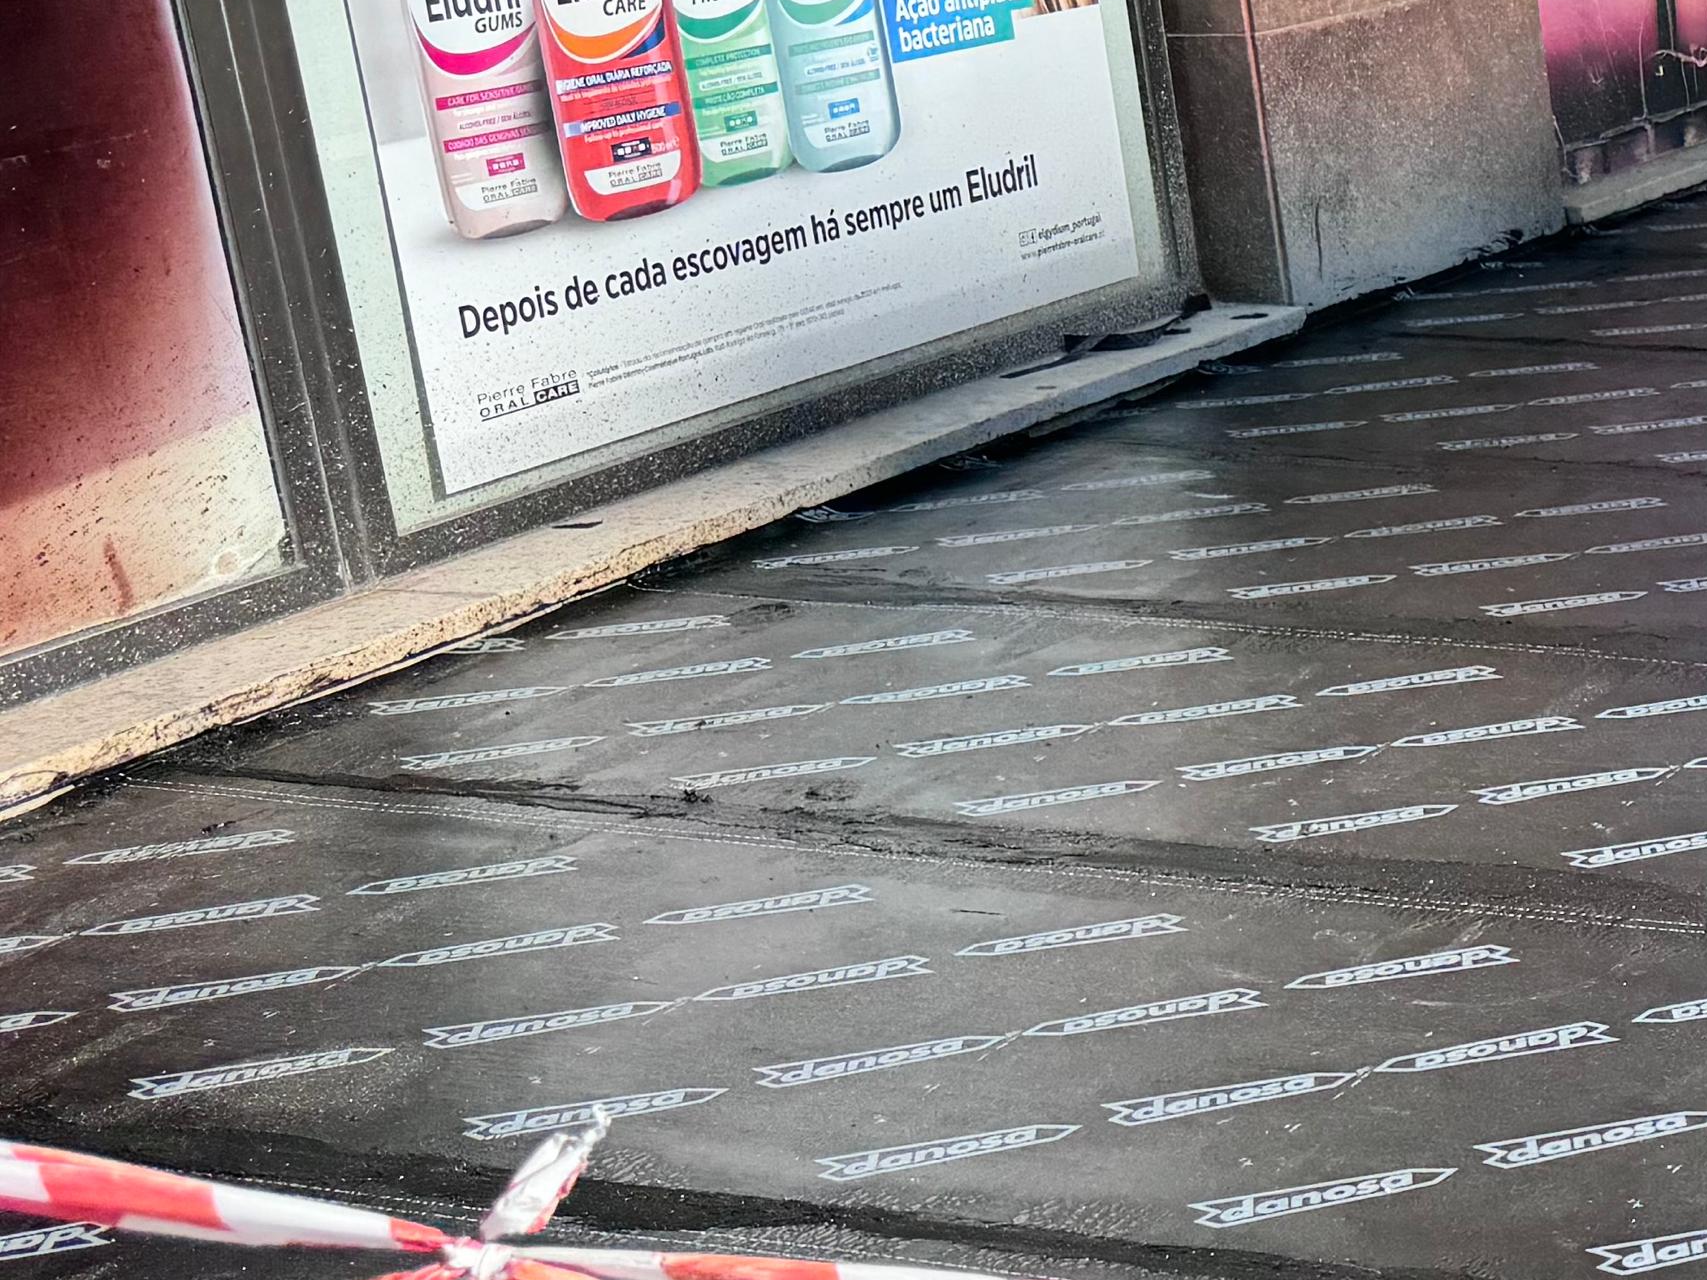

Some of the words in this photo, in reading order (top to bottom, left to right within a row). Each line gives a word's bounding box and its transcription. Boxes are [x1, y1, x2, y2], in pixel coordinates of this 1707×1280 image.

[475, 11, 523, 33] GUMS
[898, 14, 995, 53] bacteriana
[458, 285, 559, 338] Depois
[565, 275, 599, 311] de
[605, 258, 667, 299] cada
[672, 224, 807, 281] escovagem
[811, 209, 840, 244] há
[845, 193, 925, 236] sempre
[929, 185, 962, 212] um
[966, 154, 1038, 202] Eludril
[477, 384, 525, 404] Pierre
[531, 369, 576, 389] Fabre
[480, 397, 529, 418] ORAL
[535, 381, 579, 403] CARE
[120, 897, 299, 934] danosa
[682, 887, 854, 922] danosa
[418, 924, 600, 965] danosa
[993, 916, 1168, 954] danosa
[133, 968, 321, 1008] danosa
[733, 959, 911, 999] danosa
[453, 1005, 629, 1046] danosa
[1064, 992, 1248, 1034] danosa
[785, 1039, 962, 1083] danosa
[1413, 1025, 1594, 1069] danosa
[846, 1128, 1034, 1179] danosa
[1509, 1113, 1688, 1164] danosa
[1220, 1172, 1414, 1224] danosa
